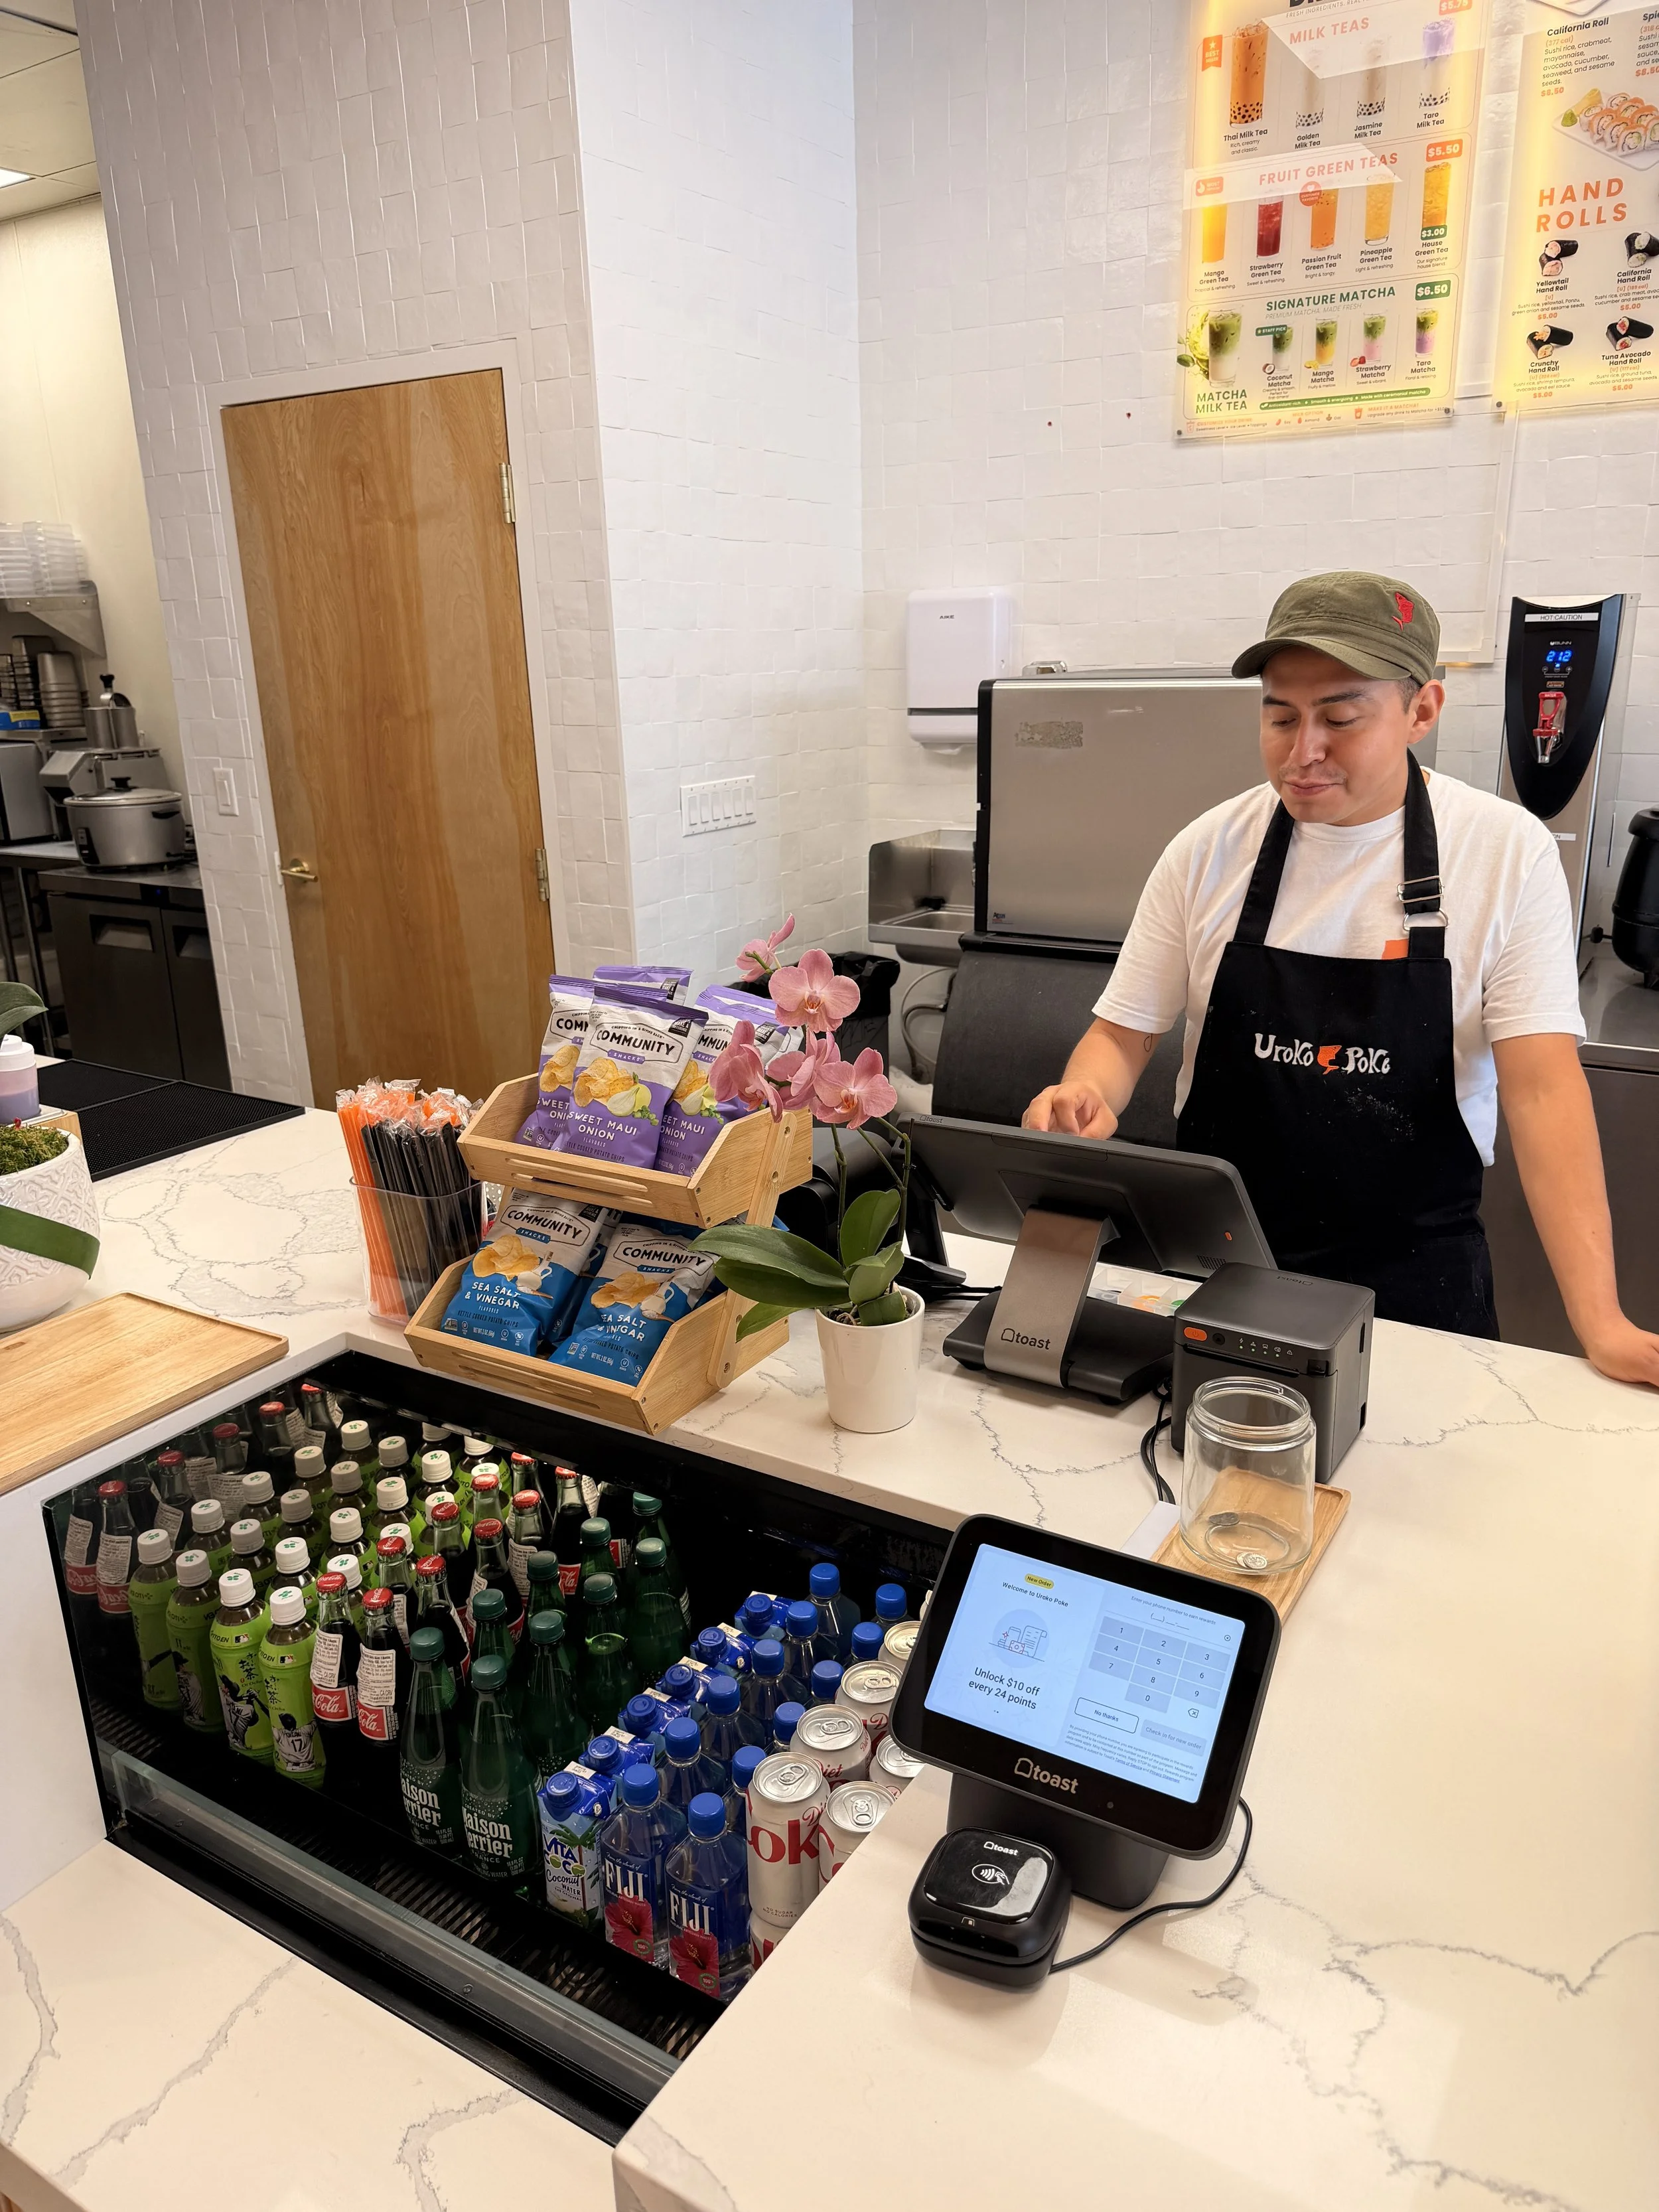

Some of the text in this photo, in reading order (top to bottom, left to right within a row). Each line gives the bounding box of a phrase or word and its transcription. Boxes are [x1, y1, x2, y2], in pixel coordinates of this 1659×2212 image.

[1286, 9, 1305, 18] FRESH
[1289, 17, 1370, 44] MILK TEAS
[1547, 17, 1609, 37] California Roll
[1577, 37, 1612, 48] crabmeat,
[1543, 53, 1610, 71] avocado, cucumber,
[1544, 51, 1585, 63] mayonnaise,
[1542, 68, 1573, 79] seaweed,
[1589, 61, 1615, 70] sesame
[1542, 78, 1562, 87] seeds.
[1540, 87, 1564, 97] $8.50
[1354, 121, 1383, 131] Jasmine
[1416, 120, 1431, 129] Milk
[1223, 128, 1268, 141] Thai Milk Tea
[1297, 133, 1319, 141] Golden
[1354, 131, 1368, 139] Milk
[1427, 143, 1460, 157] $5.50
[1259, 152, 1398, 186] FRUIT GREEN TEAS
[1538, 178, 1624, 207] HAND
[1536, 202, 1627, 233] ROLLS
[1421, 228, 1445, 238] $3.00
[1360, 247, 1393, 256] Pineapple
[1301, 253, 1342, 264] Passion Fruit
[1360, 255, 1379, 263] Green
[1250, 261, 1284, 271] Strawberry
[1305, 263, 1324, 271] Green
[1617, 267, 1652, 277] California
[1251, 269, 1269, 278] Green
[1199, 277, 1216, 285] Green
[1536, 277, 1569, 287] Yellowtail
[1417, 283, 1449, 297] $6.50
[1266, 286, 1396, 311] SIGNATURE MATCHA
[1620, 350, 1651, 359] Avocado
[1356, 364, 1392, 373] Strawberry
[1196, 389, 1248, 403] MATCHA
[1195, 400, 1248, 414] MILK TEA
[1546, 650, 1572, 662] 212
[597, 1030, 675, 1055] COMMUNITY
[613, 1052, 640, 1062] SNACKS
[568, 1111, 637, 1135] SWEET MAUI
[680, 1118, 705, 1135] MAUI
[578, 1124, 615, 1141] ONION
[583, 1137, 606, 1147] FLAVORED
[611, 1151, 625, 1162] CHIPS
[508, 1210, 583, 1239] COMMUNITY
[521, 1230, 546, 1240] SNACKS
[622, 1247, 706, 1266] COMMUNITY
[472, 1282, 521, 1297] SEA SALT
[465, 1291, 520, 1309] & VINEGAR
[478, 1305, 499, 1314] FLAVORED
[504, 1318, 519, 1327] CHIPS
[617, 1314, 646, 1329] SALT
[1015, 1332, 1050, 1350] toast
[1038, 1578, 1052, 1587] Order
[1002, 1582, 1028, 1594] Welcome
[1036, 1592, 1053, 1602] Uroko
[1054, 1597, 1069, 1607] Poke
[974, 1666, 1041, 1696] Unlock $10 off
[968, 1680, 1037, 1710] every 24 points
[1102, 1712, 1119, 1722] thanks
[1145, 1726, 1202, 1749] Check order
[292, 1739, 303, 1752] 17
[1033, 1765, 1078, 1794] toast
[401, 1777, 441, 1810] aison
[543, 1833, 579, 1864] VITA
[993, 1844, 1019, 1856] toast
[546, 1868, 583, 1887] Coconut
[605, 1858, 644, 1902] FIJI
[561, 1883, 581, 1896] WATER
[562, 1891, 582, 1901] ORIGINAL
[669, 1889, 710, 1936] FIJI
